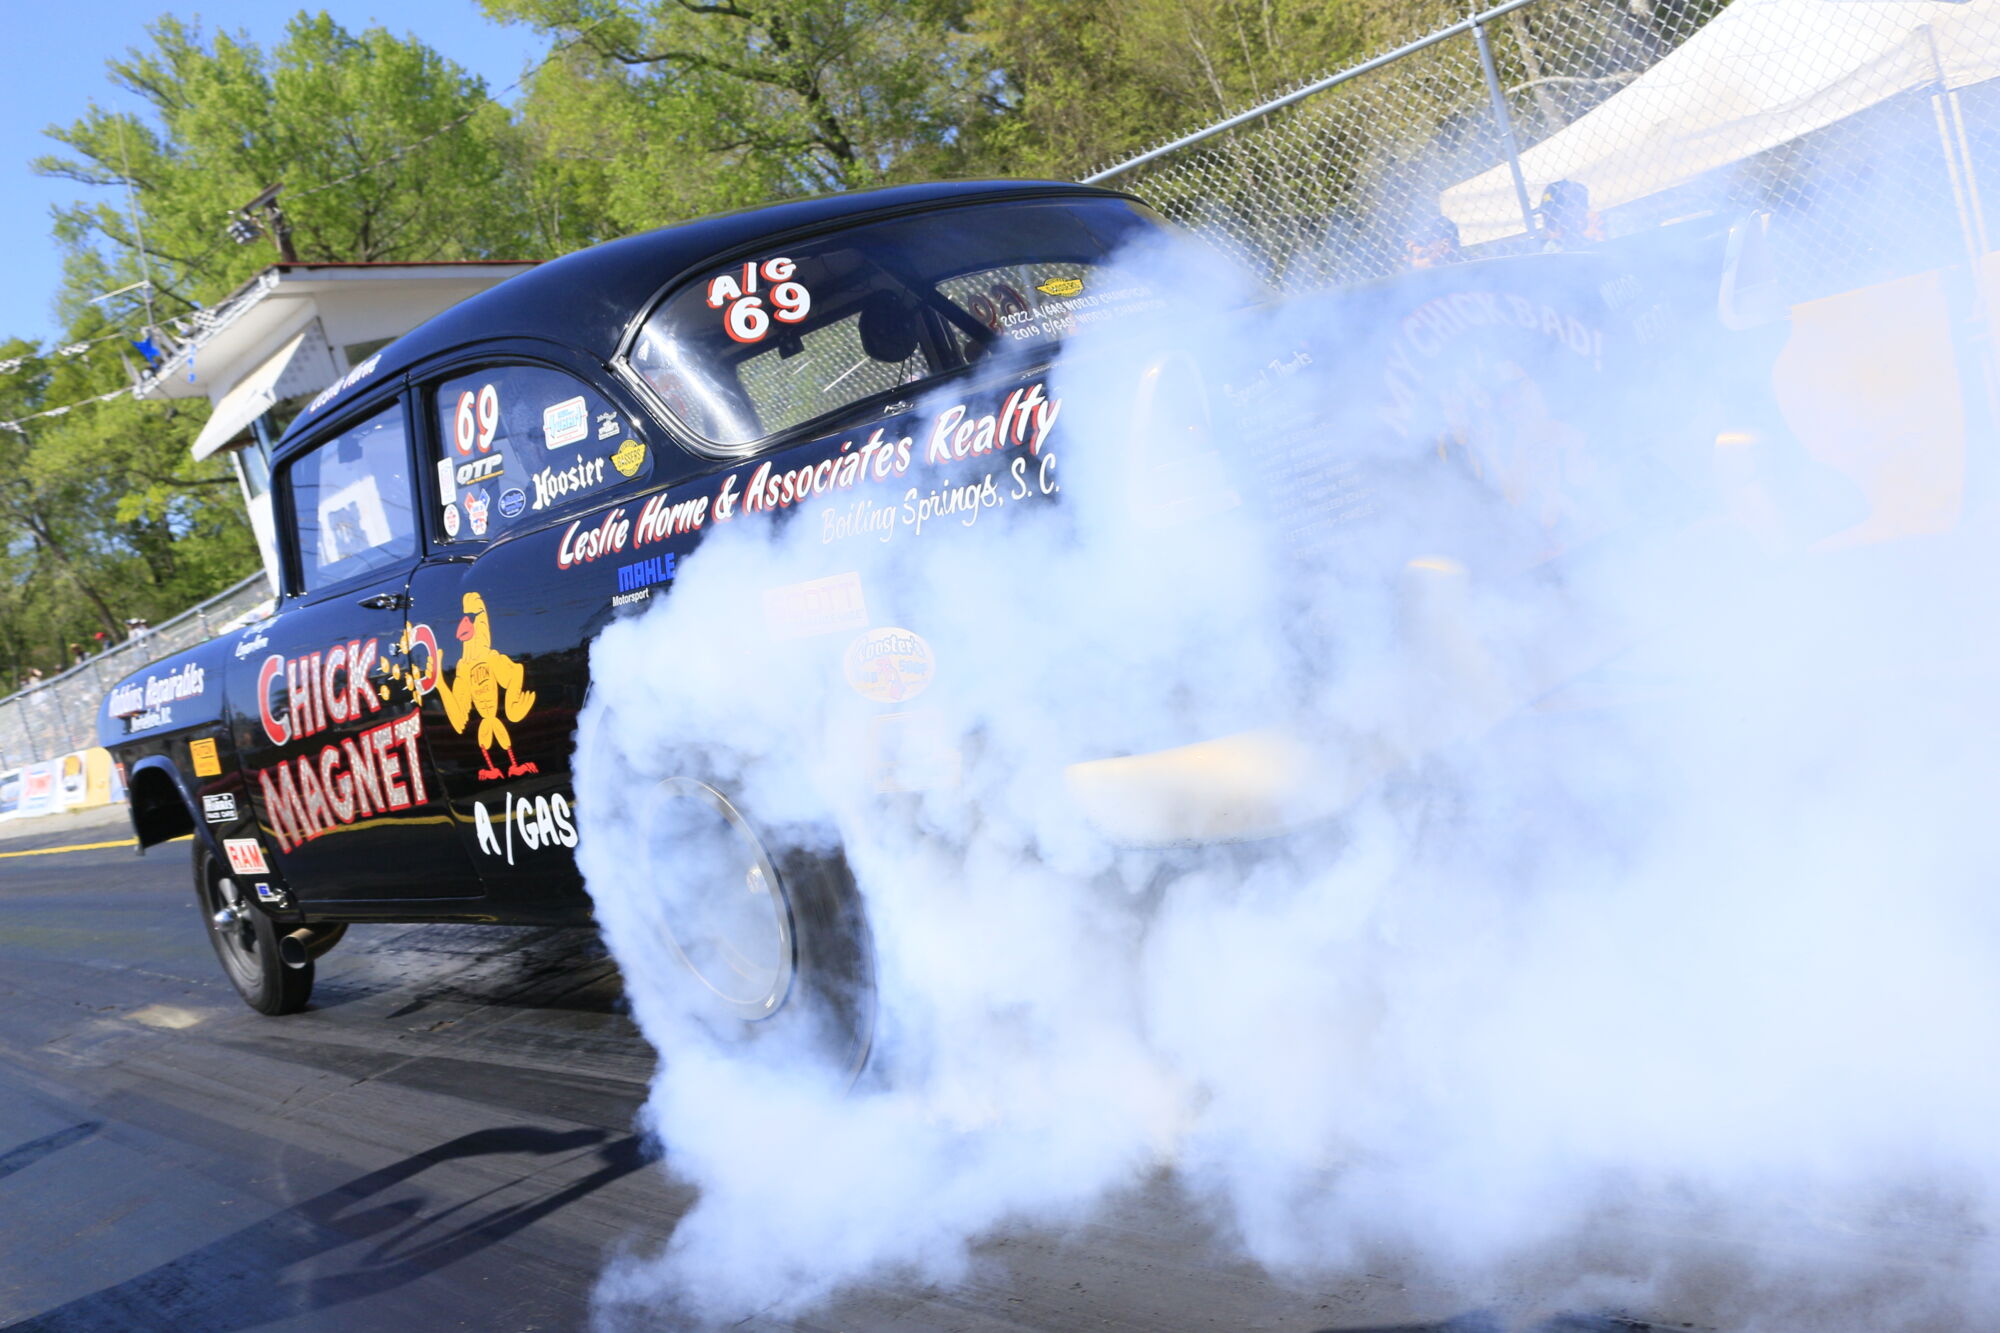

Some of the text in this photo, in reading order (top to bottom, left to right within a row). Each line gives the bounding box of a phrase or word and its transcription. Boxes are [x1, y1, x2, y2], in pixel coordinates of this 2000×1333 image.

[724, 282, 811, 343] 69
[1000, 311, 1033, 327] 2022
[1033, 301, 1067, 323] A/GAS
[1063, 296, 1099, 314] WORLD
[1011, 325, 1041, 341] 2019
[1042, 316, 1076, 338] C/GAS
[1078, 308, 1113, 327] WORLD
[1375, 290, 1603, 438] MY CHICK BAD!
[454, 383, 499, 456] 69
[532, 454, 604, 510] Hoosier
[557, 508, 630, 570] Leslie
[633, 493, 709, 549] Horne
[712, 474, 741, 523] &
[742, 427, 913, 517] Associates
[927, 383, 1062, 466] Realty
[822, 500, 896, 544] Boiling
[902, 473, 1004, 536] Springs,
[612, 587, 650, 607] Motorsport
[617, 552, 676, 593] MAHLE
[257, 638, 382, 746] CHICK
[258, 706, 429, 855] MAGNET
[228, 844, 265, 868] RAM
[473, 791, 579, 866] A/GAS
